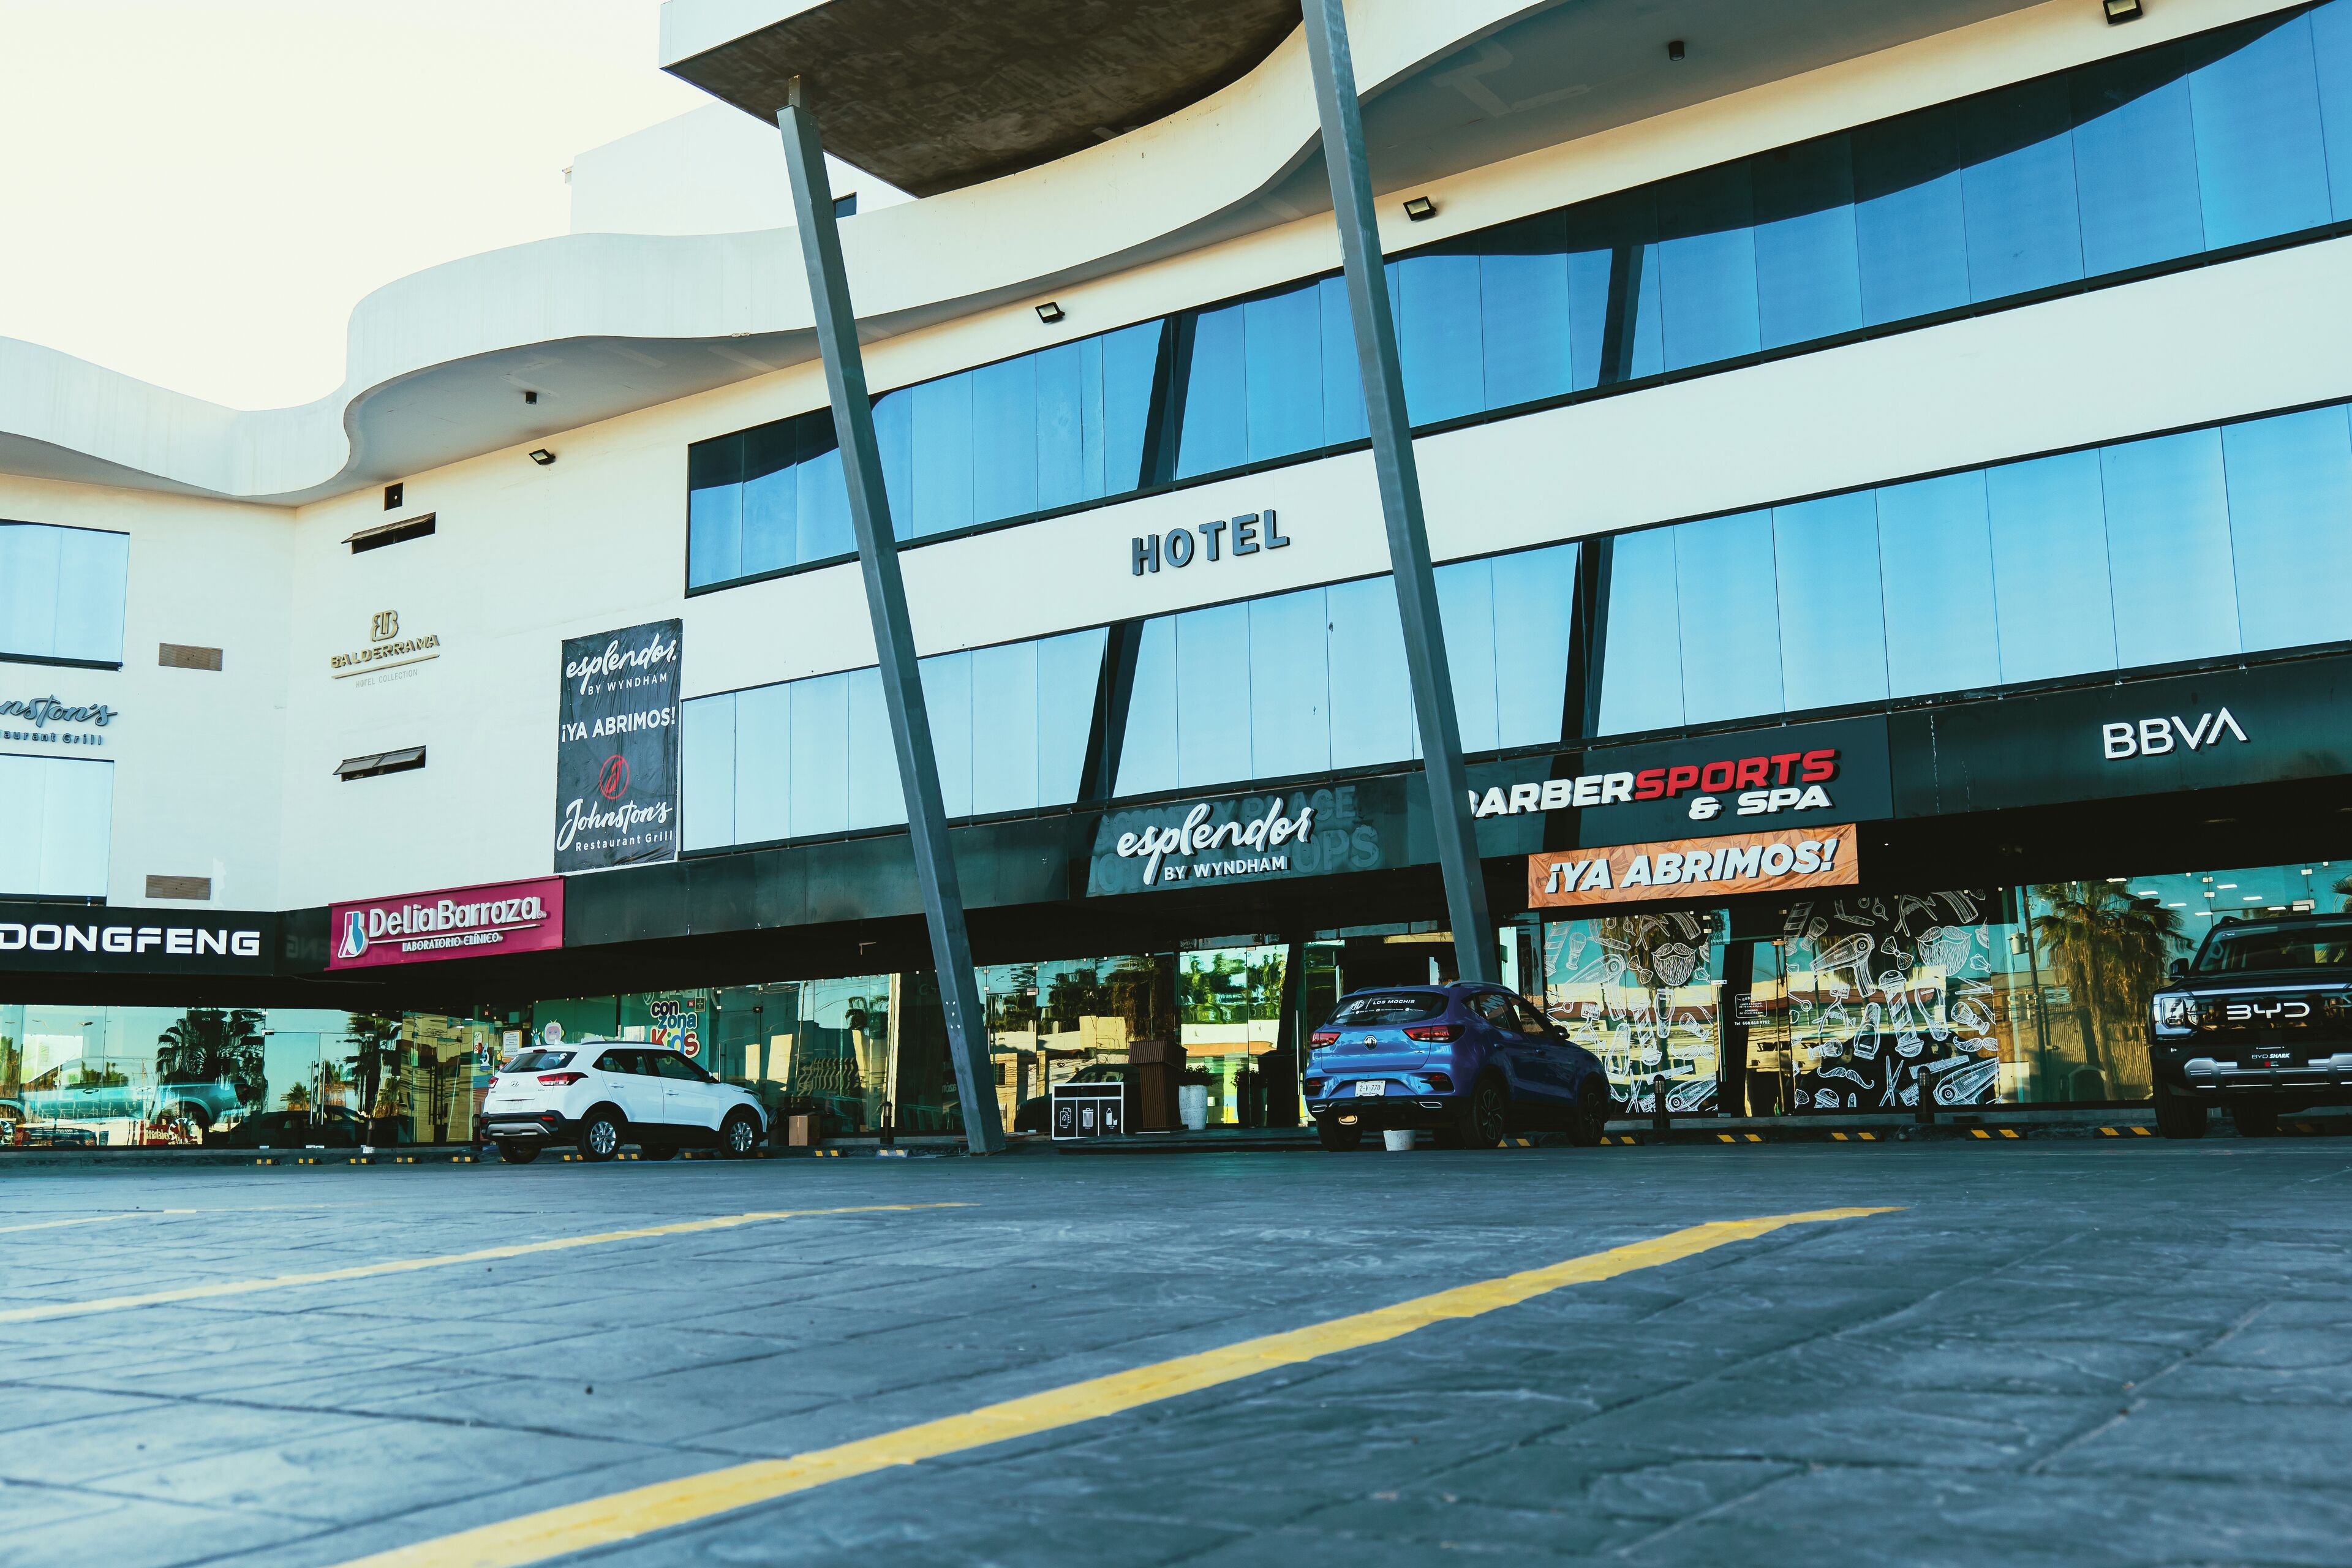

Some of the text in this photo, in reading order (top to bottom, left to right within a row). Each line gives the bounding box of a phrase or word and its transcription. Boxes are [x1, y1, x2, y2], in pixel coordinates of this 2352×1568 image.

[1132, 509, 1290, 576] HOTEL
[331, 635, 440, 668] BALDERRAMA
[356, 669, 418, 688] HOTEL COLLECTION
[589, 673, 667, 695] BY WYNDHAM
[592, 706, 676, 737] ABRIMOS!
[2103, 707, 2248, 759] BBVA
[0, 729, 102, 745] aurant Grill
[1689, 785, 1832, 820] & SPA
[557, 798, 673, 851] Johnston's
[576, 831, 672, 851] Restaurant Grill
[1117, 797, 1316, 886] esplendor
[1164, 865, 1187, 881] BY
[1193, 856, 1289, 878] WYNDHAM
[1622, 839, 1839, 889] ABRIMOS!
[0, 924, 260, 956] DONGFENG
[402, 932, 502, 952] LABORATORIO CLÍNICO
[658, 1013, 697, 1029] zona
[2226, 1002, 2310, 1020] BYD
[652, 1028, 698, 1055] Kids
